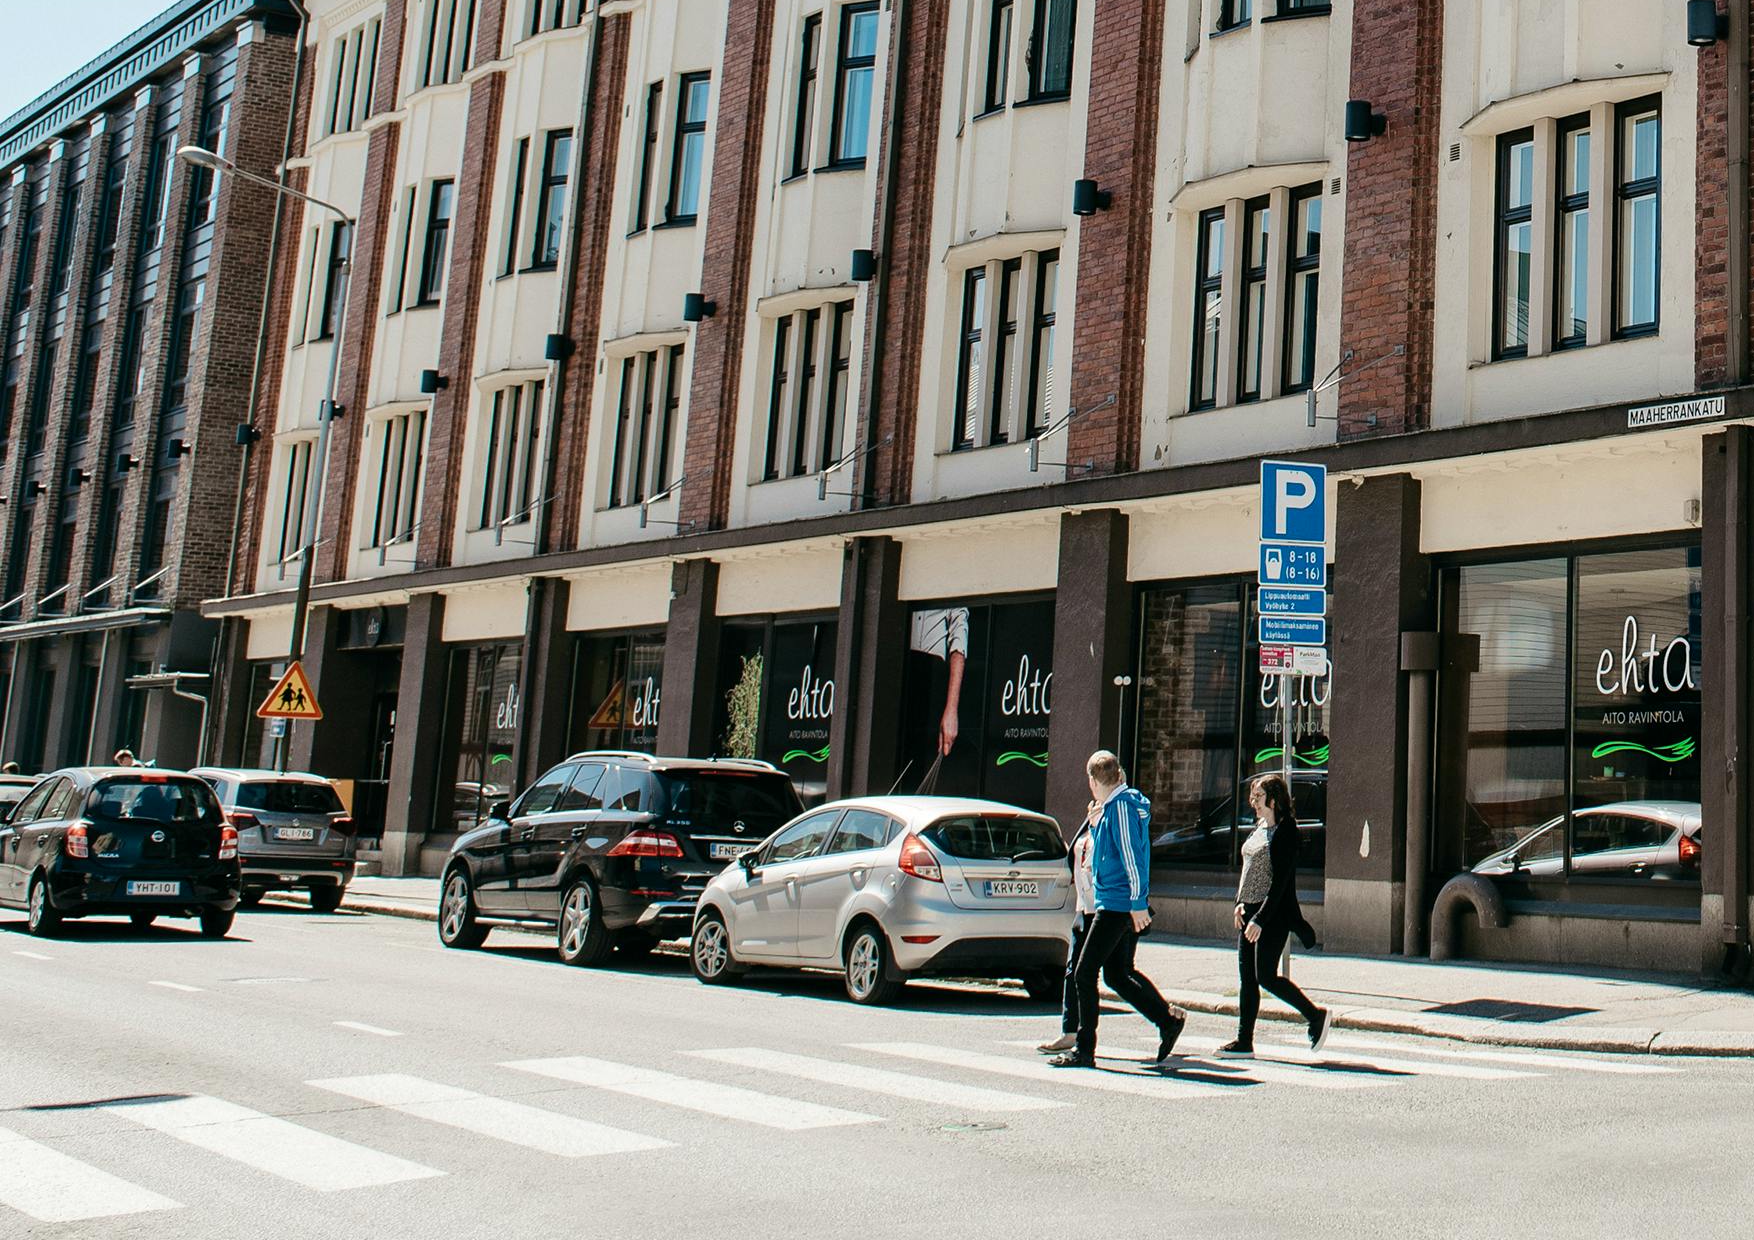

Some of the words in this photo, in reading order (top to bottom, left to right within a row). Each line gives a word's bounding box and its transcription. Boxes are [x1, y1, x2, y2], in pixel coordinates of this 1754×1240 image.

[1629, 399, 1723, 425] MAAHERRANKATU
[1275, 469, 1316, 534] P
[1597, 615, 1695, 695] ehta
[497, 683, 519, 729] eht
[633, 676, 660, 727] eht
[787, 664, 835, 720] ehta
[1004, 728, 1019, 738] AITO
[1020, 727, 1049, 738] RAVINTOL
[1602, 712, 1625, 725] AITO
[1628, 710, 1684, 724] RAVINTOLA
[136, 883, 176, 893] YHT-101
